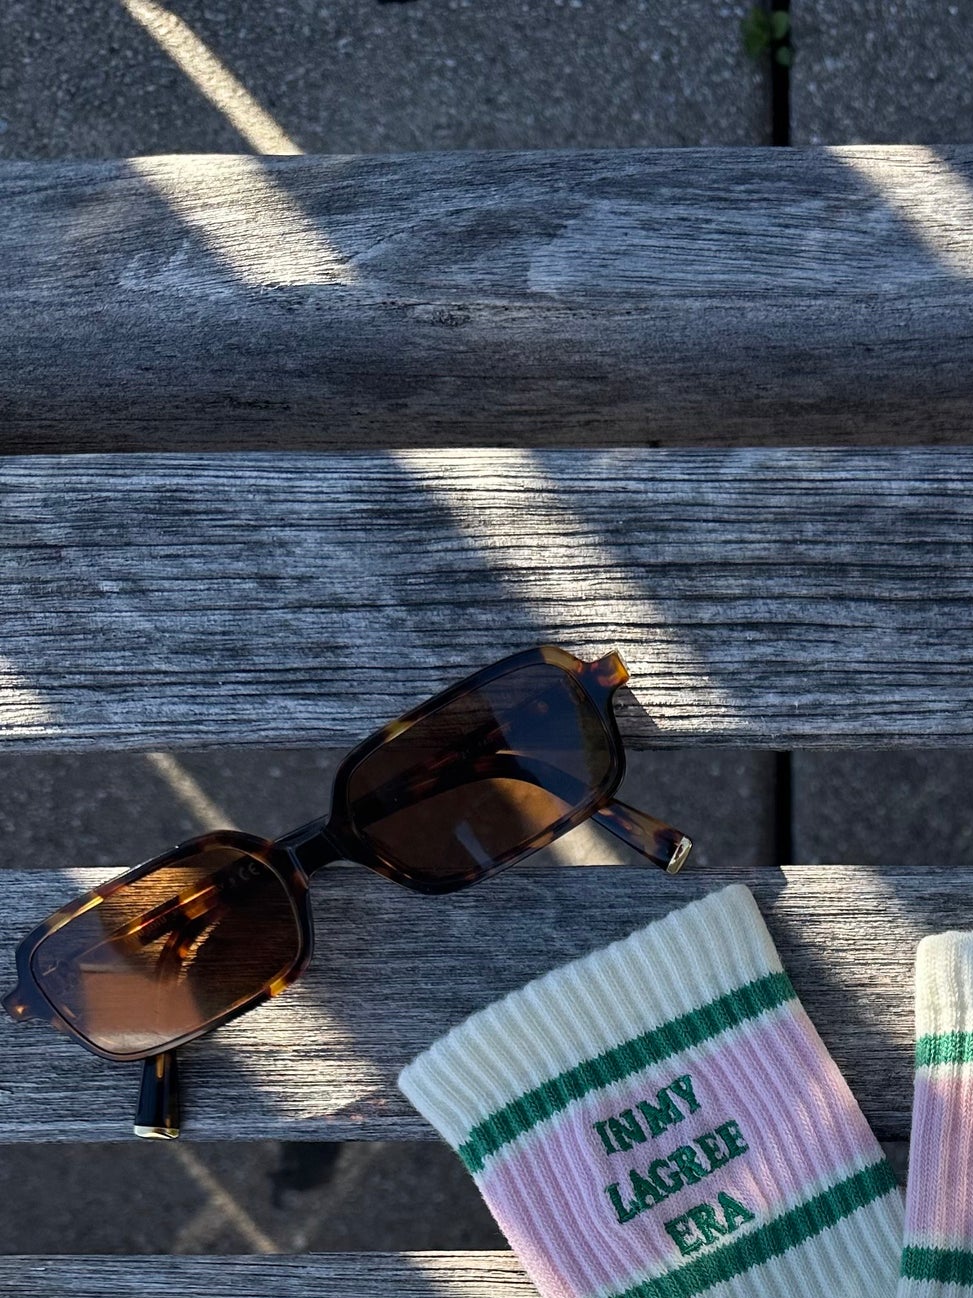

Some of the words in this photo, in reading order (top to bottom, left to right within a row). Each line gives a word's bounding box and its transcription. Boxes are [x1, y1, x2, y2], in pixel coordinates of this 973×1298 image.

[593, 1108, 648, 1155] IN
[636, 1074, 701, 1139] MY
[604, 1119, 749, 1225] LAGREE
[663, 1191, 755, 1256] ERA
